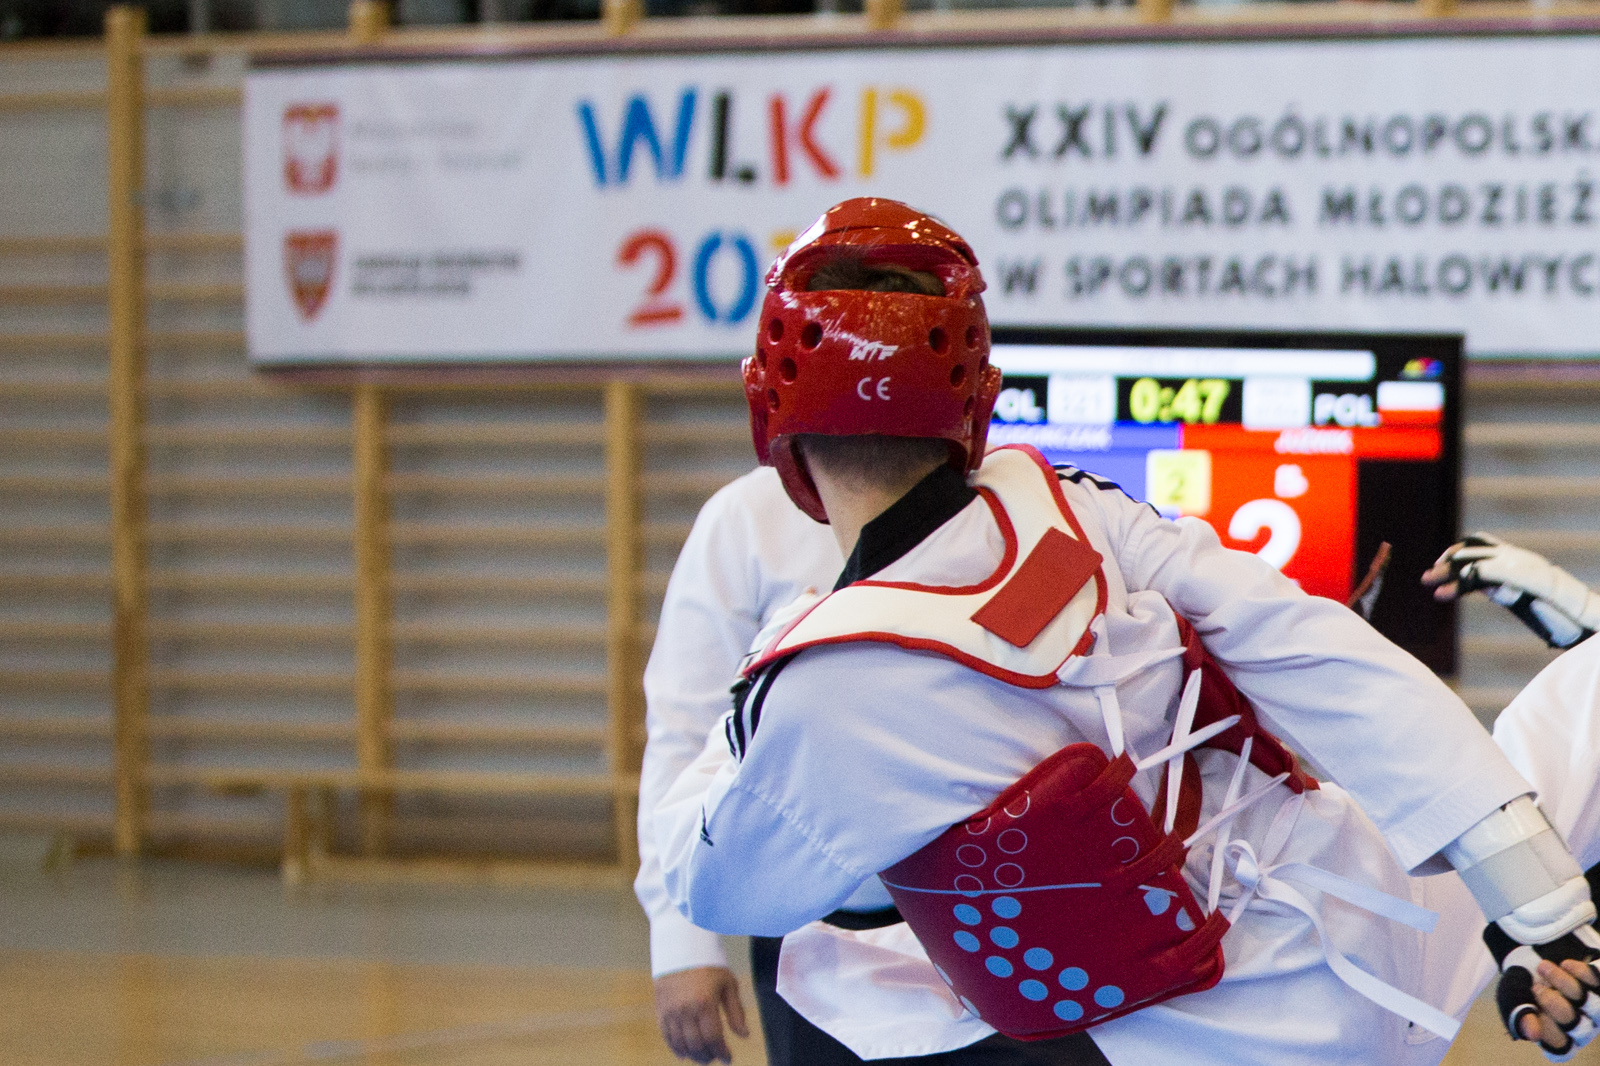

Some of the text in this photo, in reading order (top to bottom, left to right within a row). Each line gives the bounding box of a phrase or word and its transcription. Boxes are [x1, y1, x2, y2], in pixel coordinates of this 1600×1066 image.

[579, 86, 926, 185] WLKP
[1003, 102, 1167, 158] XXIV
[997, 186, 1289, 228] OLIMPIADA
[616, 228, 795, 329] 20
[999, 256, 1042, 296] W
[1066, 255, 1316, 297] SPORTACH
[857, 377, 891, 401] CE
[996, 388, 1044, 422] OL
[1129, 378, 1229, 424] 0:47
[1313, 393, 1380, 427] POL
